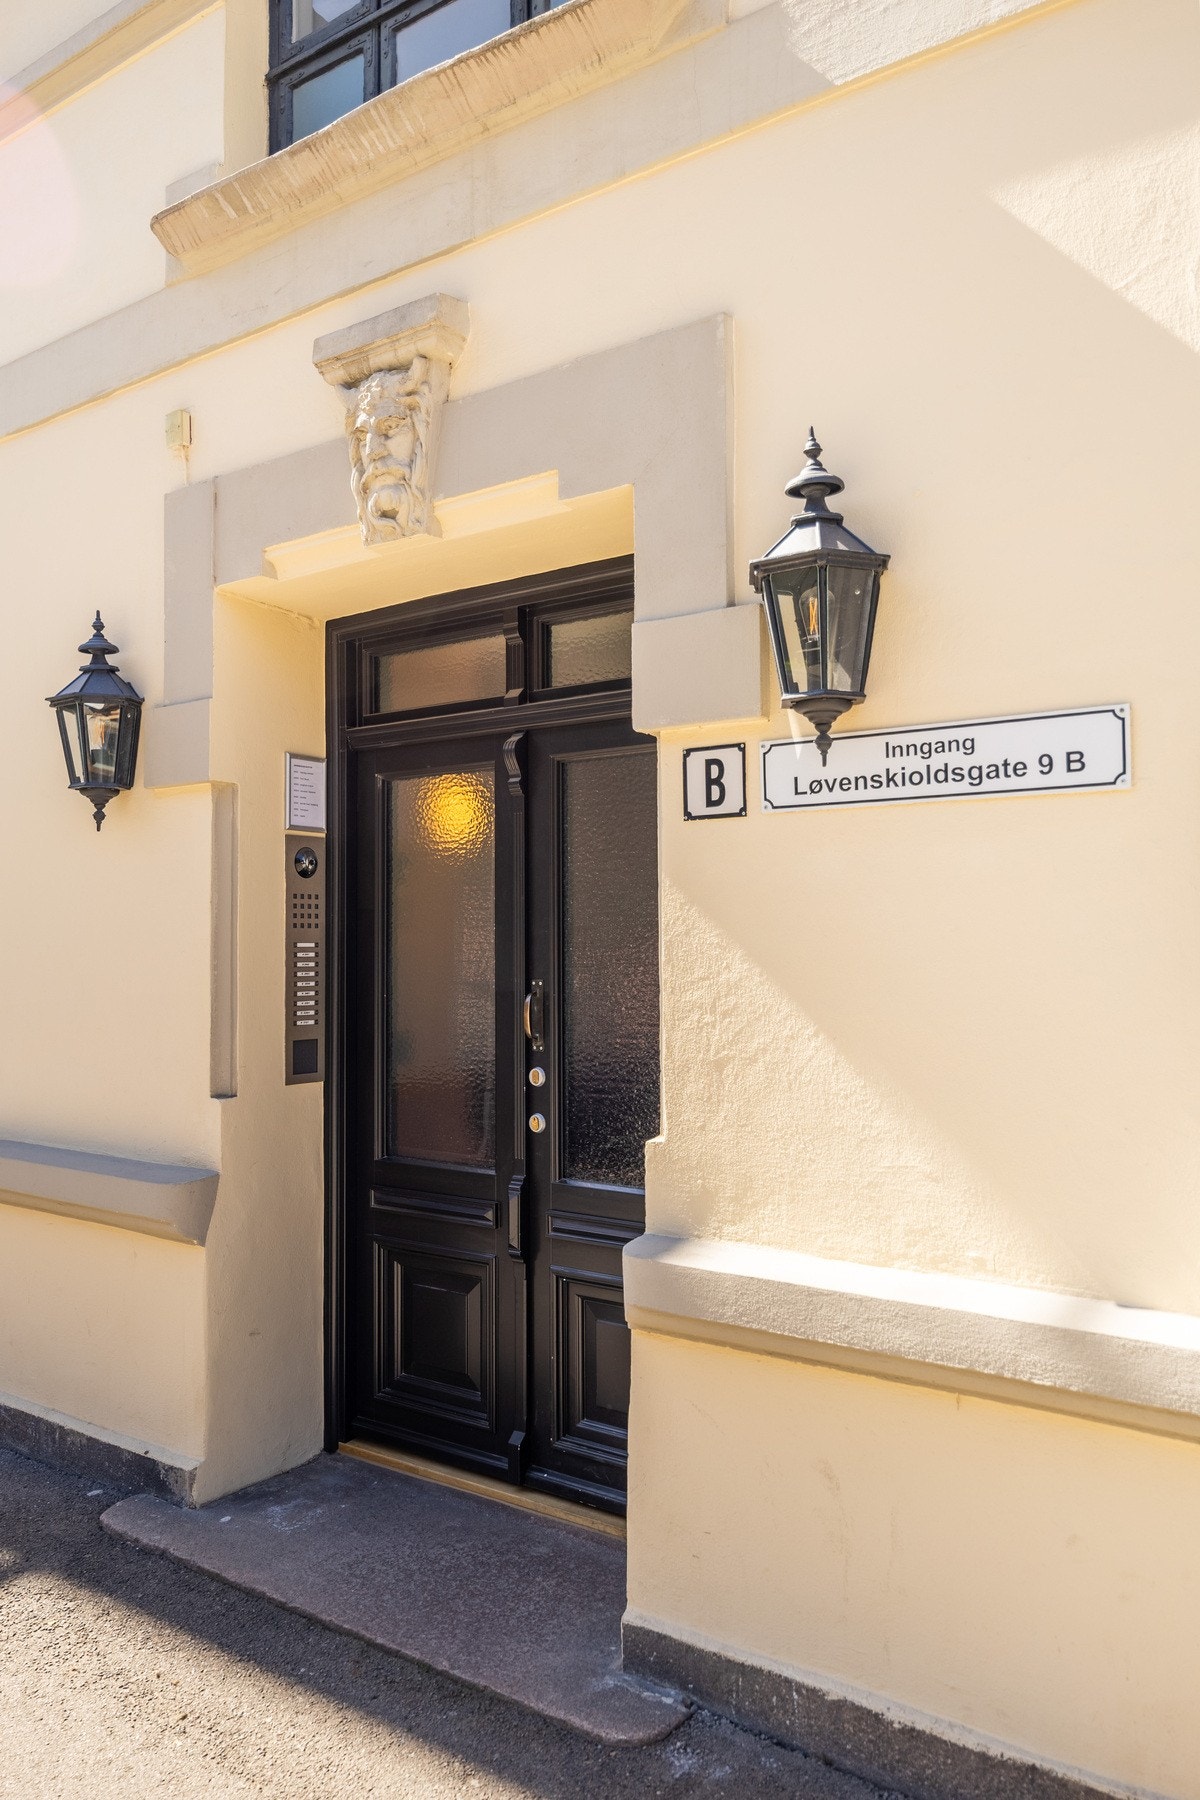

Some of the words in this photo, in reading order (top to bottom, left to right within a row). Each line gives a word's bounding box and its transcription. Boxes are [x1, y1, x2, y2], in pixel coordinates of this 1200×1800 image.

[885, 737, 975, 760] Inngang
[705, 758, 726, 809] B
[793, 758, 1028, 796] Løvenskioldsgate
[1038, 753, 1054, 776] 9
[1065, 750, 1086, 773] B
